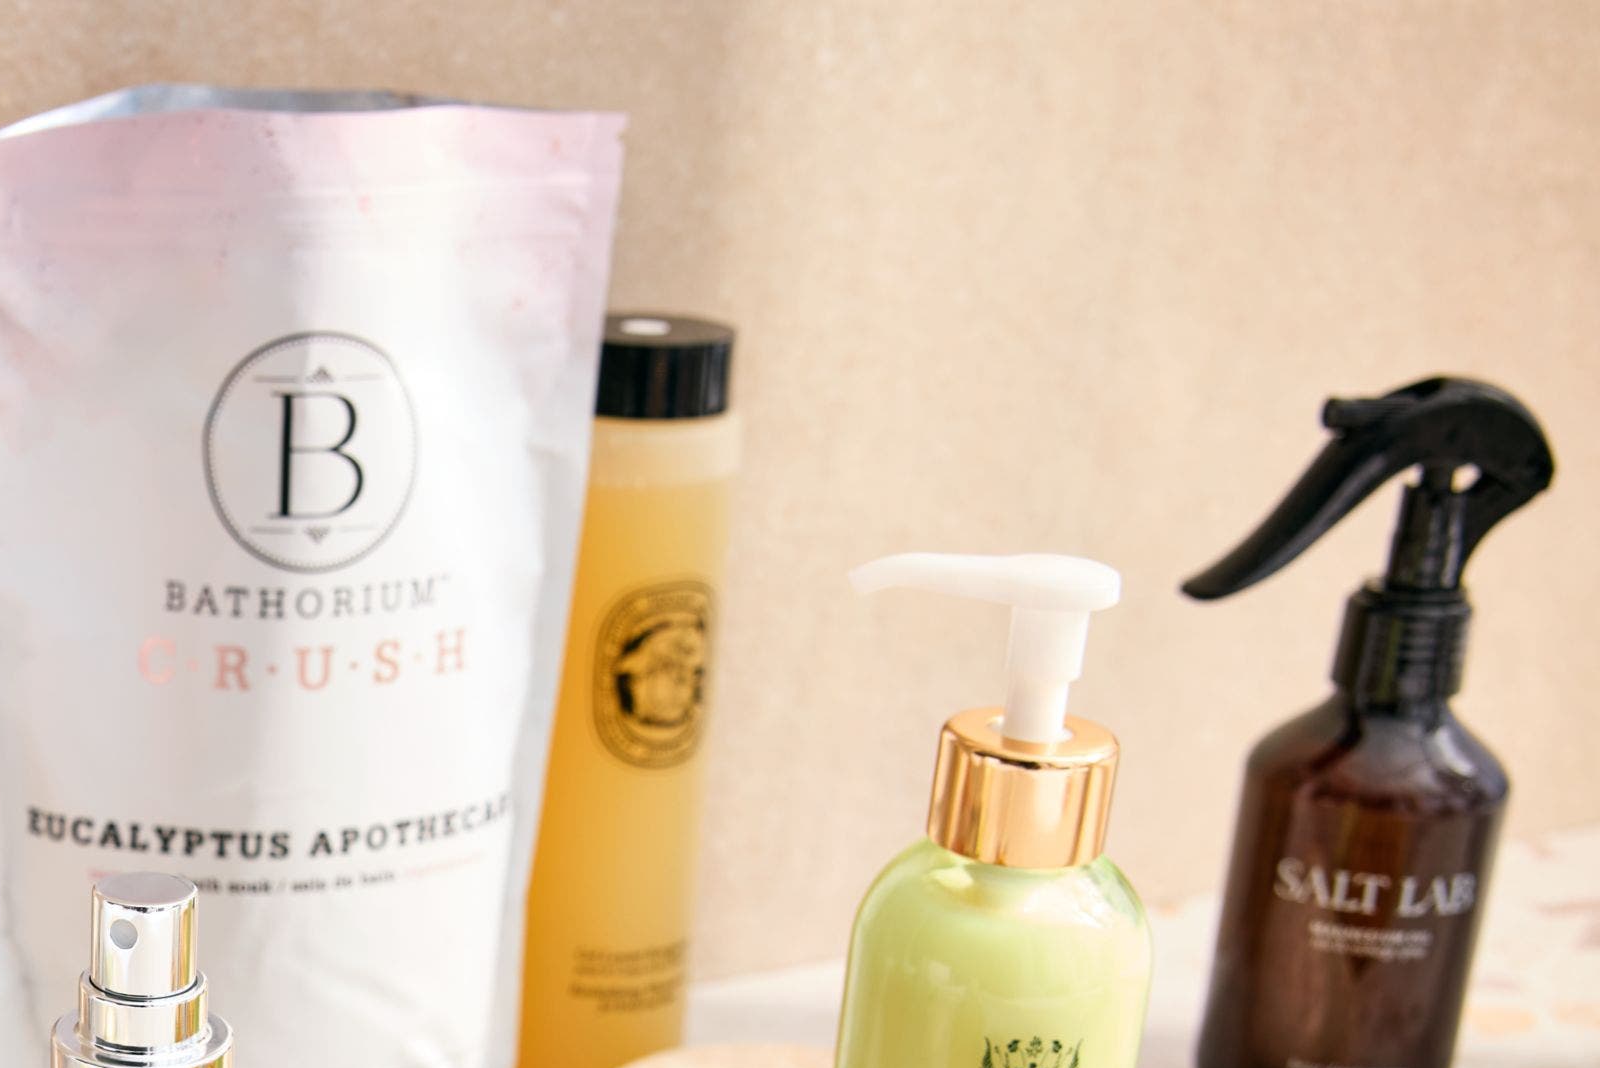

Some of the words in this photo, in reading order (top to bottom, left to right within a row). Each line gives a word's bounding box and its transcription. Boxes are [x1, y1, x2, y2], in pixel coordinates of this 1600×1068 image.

[267, 388, 366, 520] B
[165, 578, 438, 620] BATHORIUM
[27, 804, 292, 859] EUCALYPTUS
[1273, 856, 1392, 915] SALT
[1397, 872, 1477, 919] LAB
